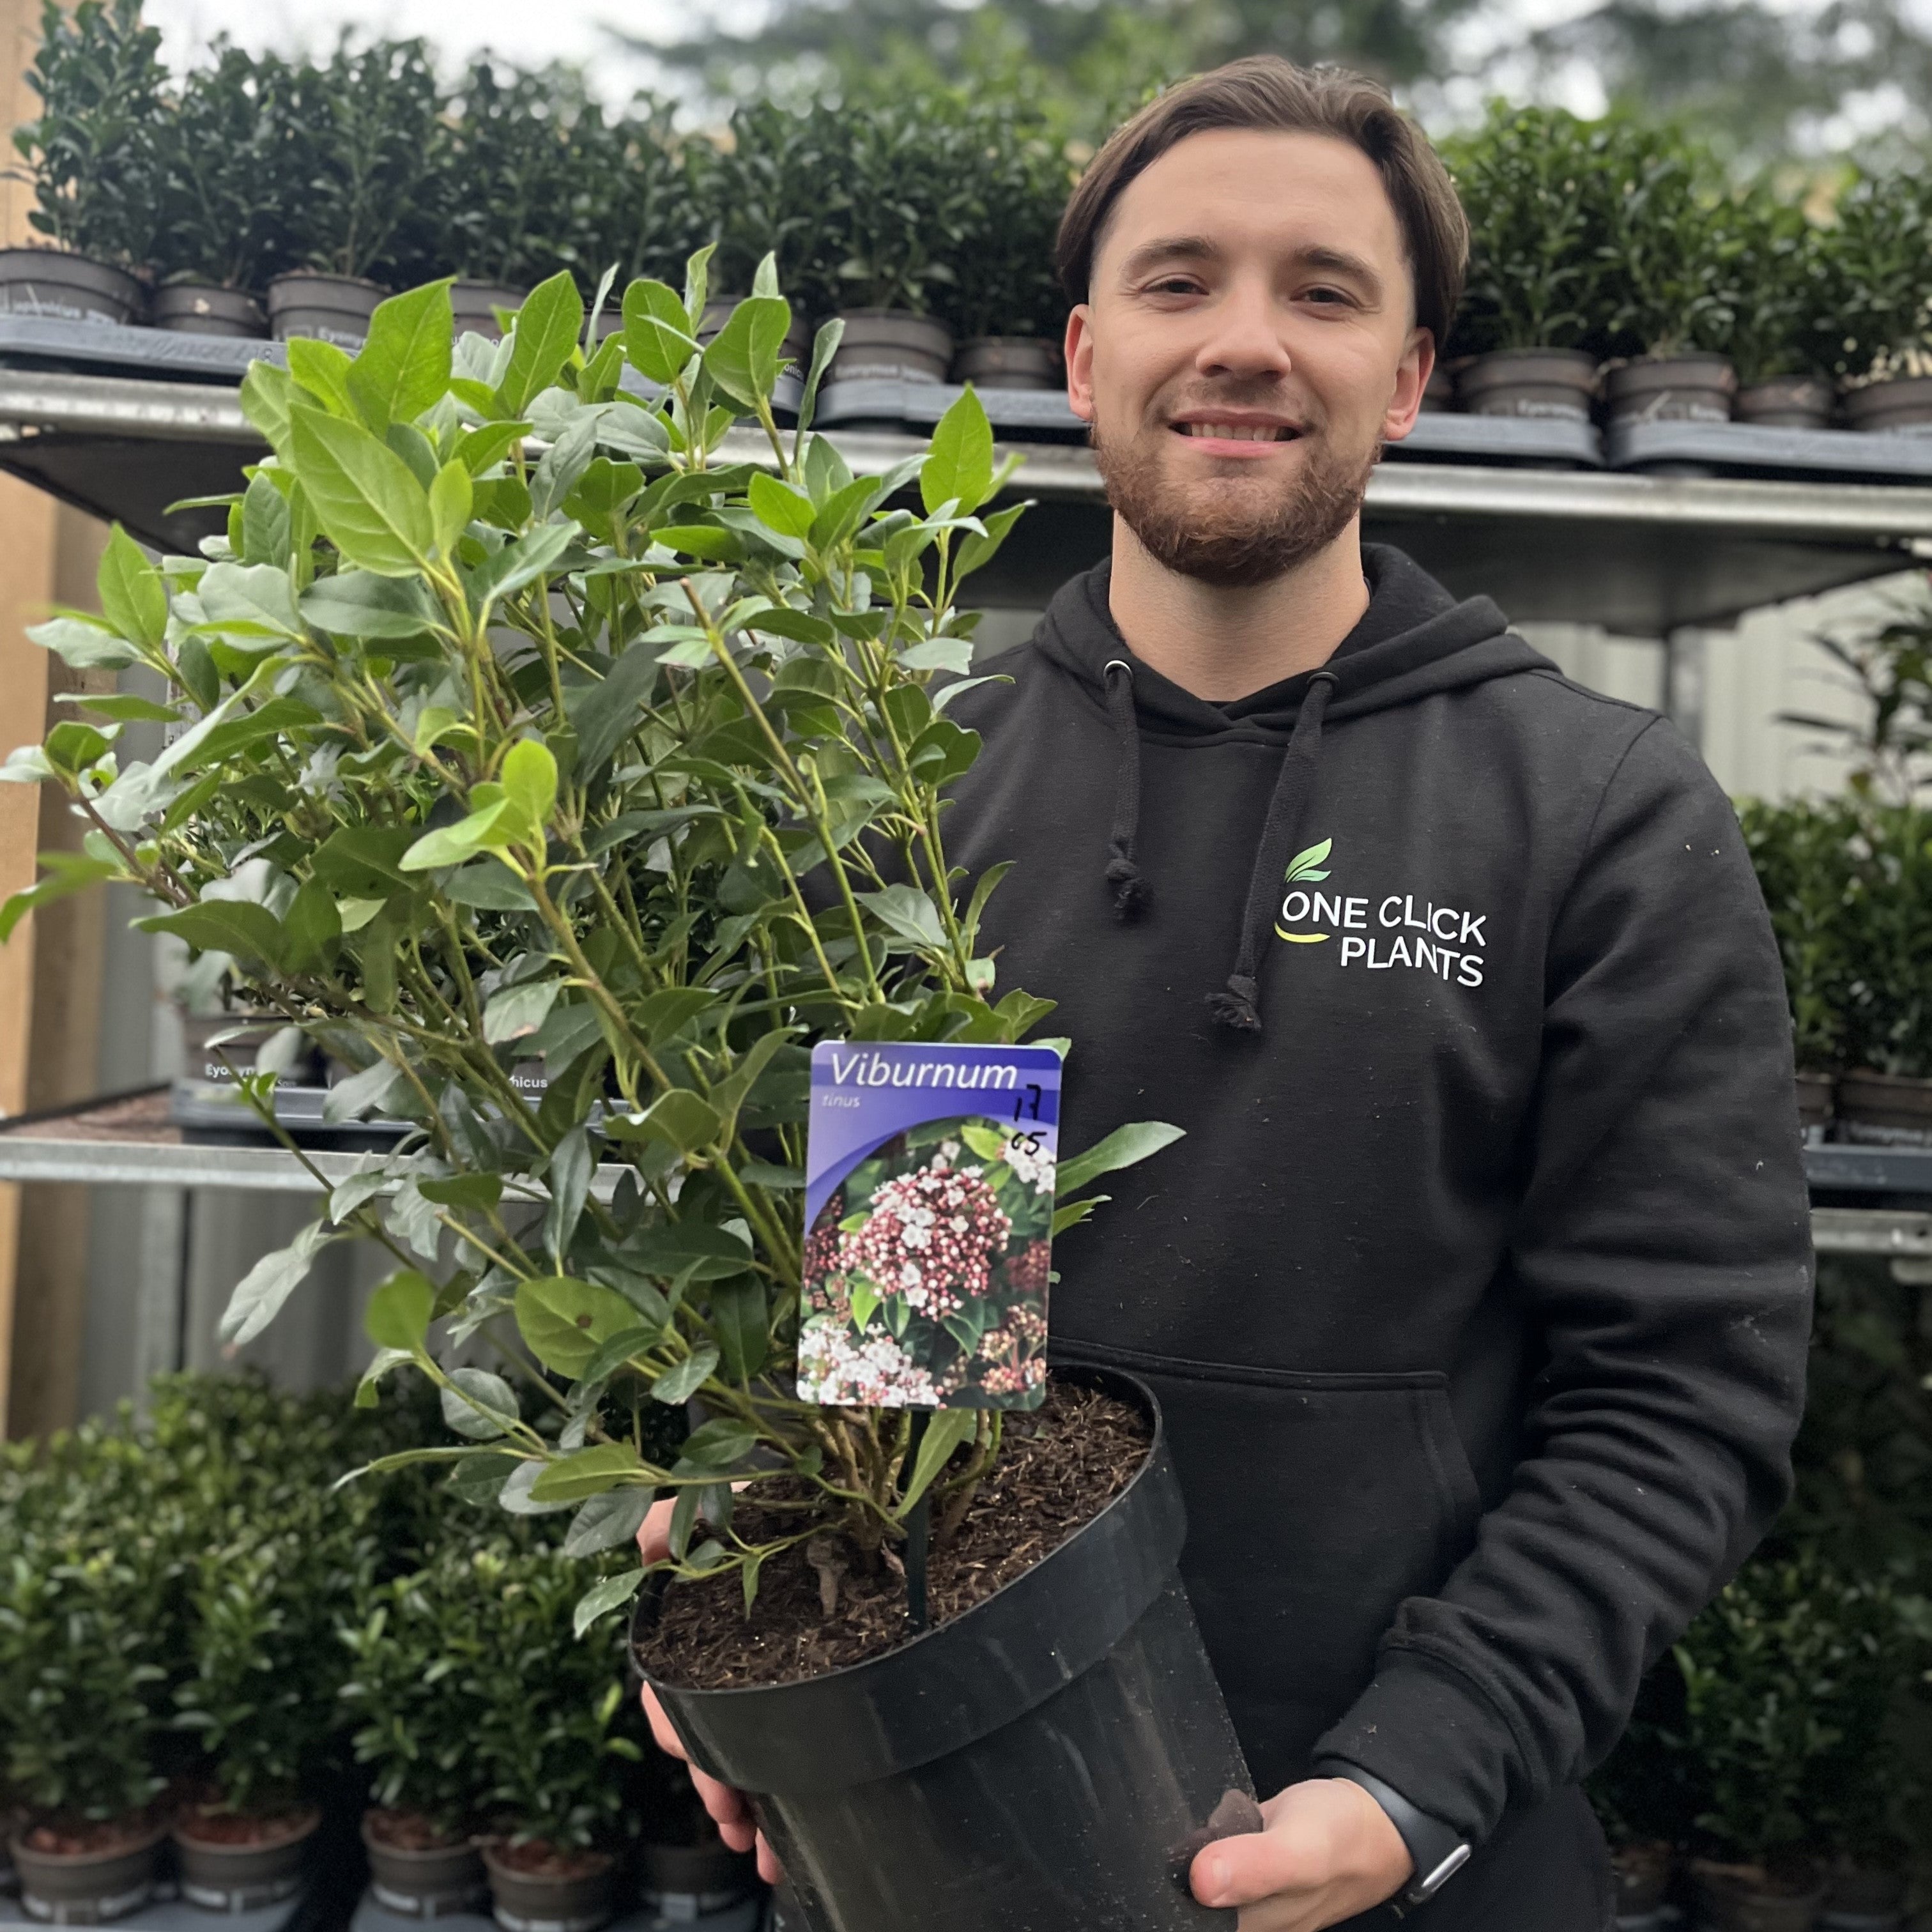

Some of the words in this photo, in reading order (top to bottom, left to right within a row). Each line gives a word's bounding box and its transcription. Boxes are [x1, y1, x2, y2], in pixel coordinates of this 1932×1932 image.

[1282, 891, 1369, 929] ONE
[1379, 894, 1487, 947] CLICK
[1340, 935, 1484, 988] PLANTS
[832, 1053, 1018, 1089] Viburnum
[822, 1094, 861, 1108] tinus
